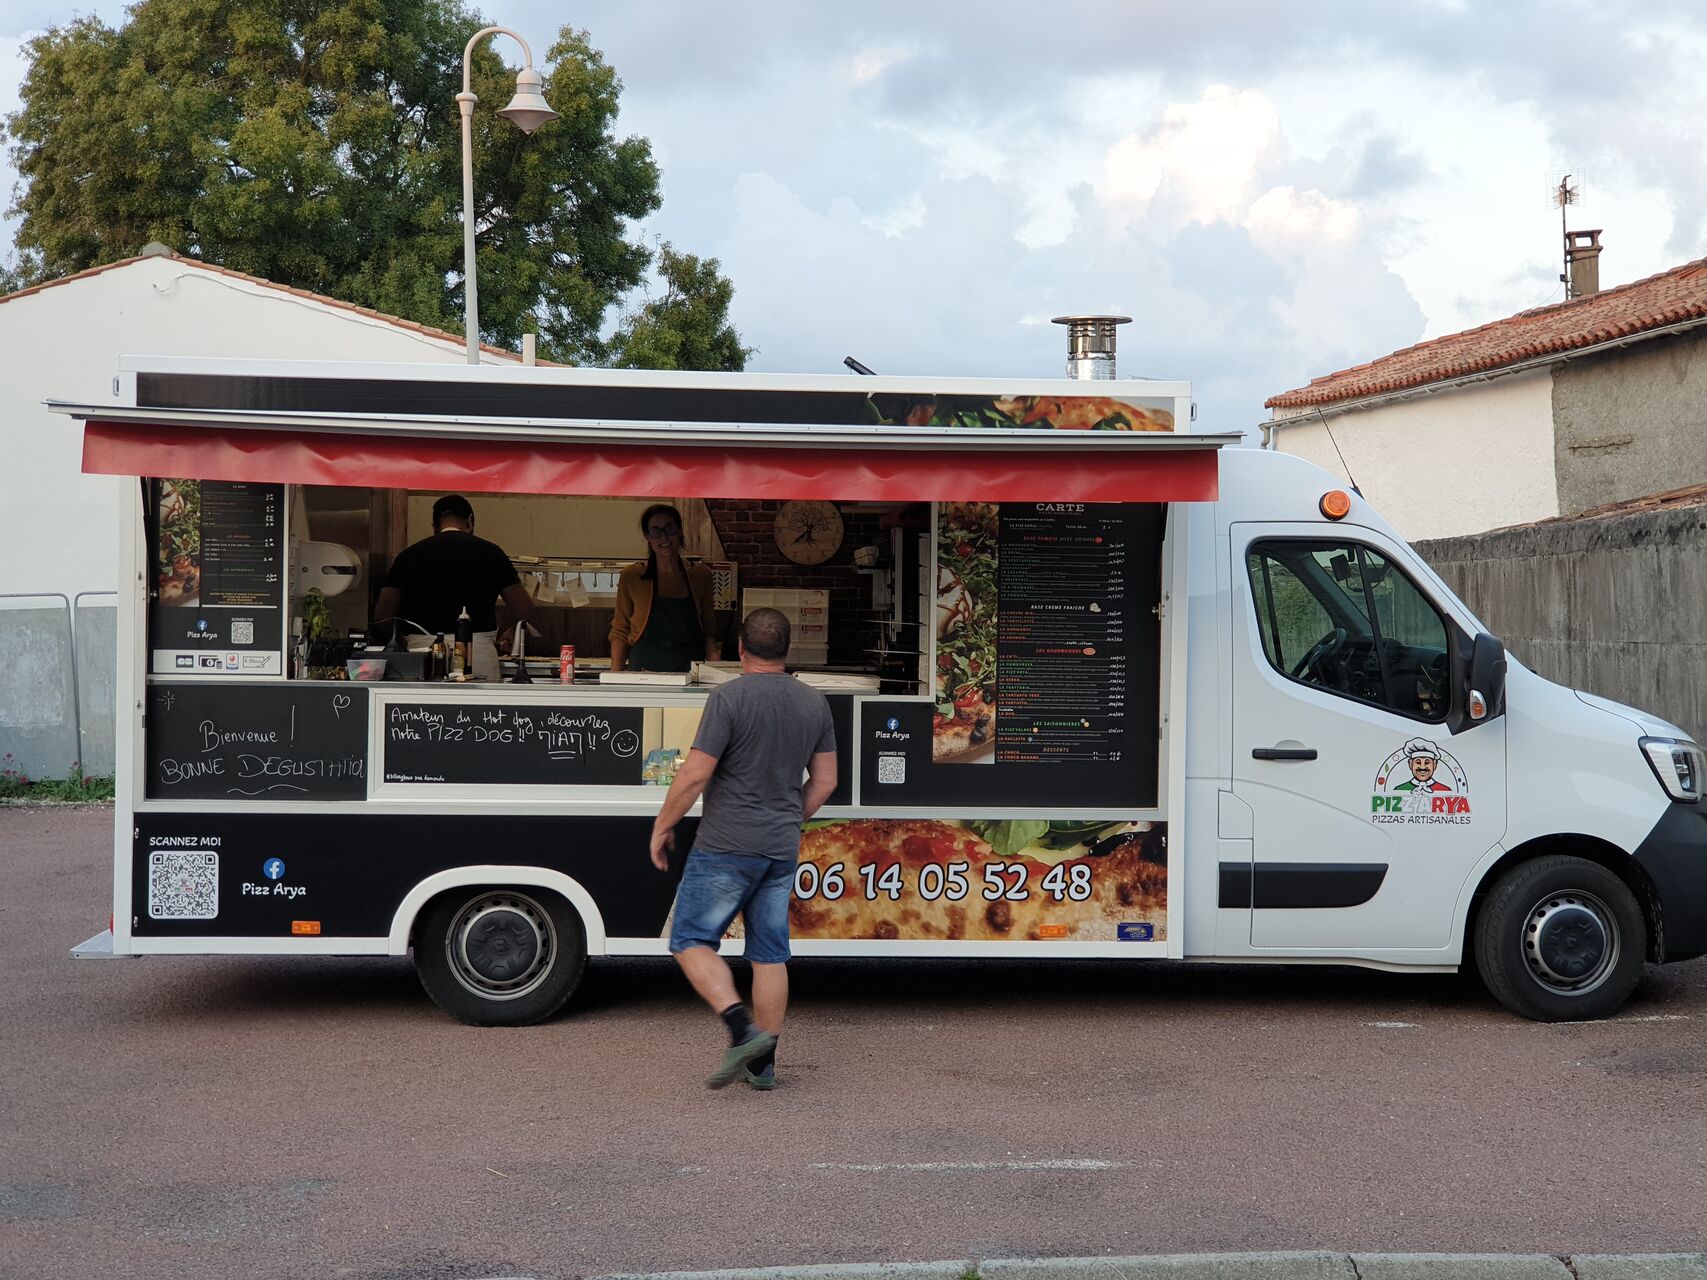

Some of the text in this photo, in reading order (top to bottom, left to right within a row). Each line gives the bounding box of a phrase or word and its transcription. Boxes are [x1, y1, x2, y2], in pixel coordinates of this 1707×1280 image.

[1036, 503, 1085, 512] CARTE
[187, 631, 218, 640] Pizz Arya
[457, 710, 472, 724] du
[483, 709, 507, 725] Hot
[200, 720, 278, 752] Bienvenue
[875, 730, 910, 741] Pizz Arya
[160, 757, 226, 784] BONNE
[1371, 815, 1472, 825] PIZZAS ARTISANALES
[149, 836, 221, 847] SCANNEZ MOI
[793, 861, 1093, 901] 06 14 05 52 48
[242, 882, 307, 900] Pizz Arya
